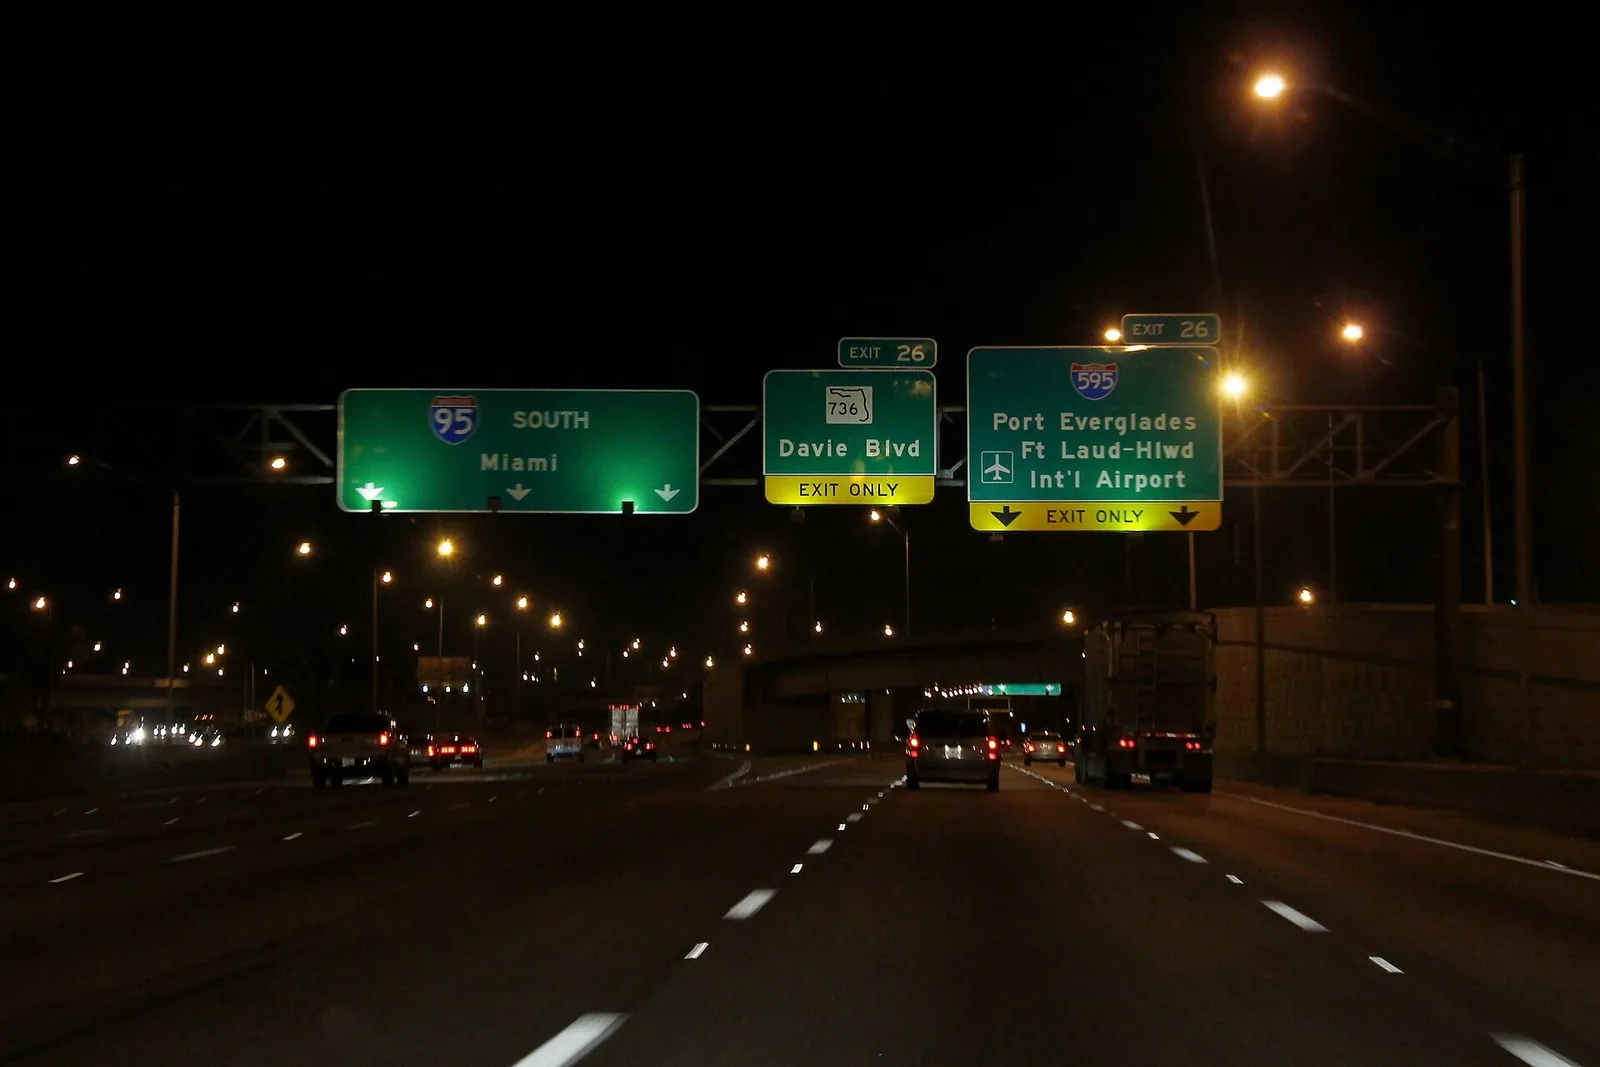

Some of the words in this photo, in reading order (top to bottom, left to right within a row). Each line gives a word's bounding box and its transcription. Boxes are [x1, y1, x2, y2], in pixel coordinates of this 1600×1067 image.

[1133, 323, 1164, 335] EXIT
[1181, 321, 1208, 338] 26
[850, 347, 881, 359] EXIT
[897, 345, 925, 361] 26
[1077, 373, 1114, 390] 595
[828, 403, 858, 416] 736
[434, 408, 474, 435] 95
[513, 411, 589, 429] SOUTH
[993, 413, 1045, 430] Port
[1060, 413, 1196, 435] Everglades
[779, 439, 848, 457] Davie
[866, 439, 920, 457] Blvd
[1021, 441, 1045, 459] Ft
[1061, 441, 1194, 459] Laud-Hlwd
[480, 454, 558, 471] Miami
[1030, 470, 1081, 488] Int'l
[1096, 470, 1186, 492] Airport
[799, 483, 839, 497] EXIT
[850, 483, 899, 497] ONLY
[1047, 510, 1086, 523] EXIT
[1095, 510, 1144, 523] ONLY
